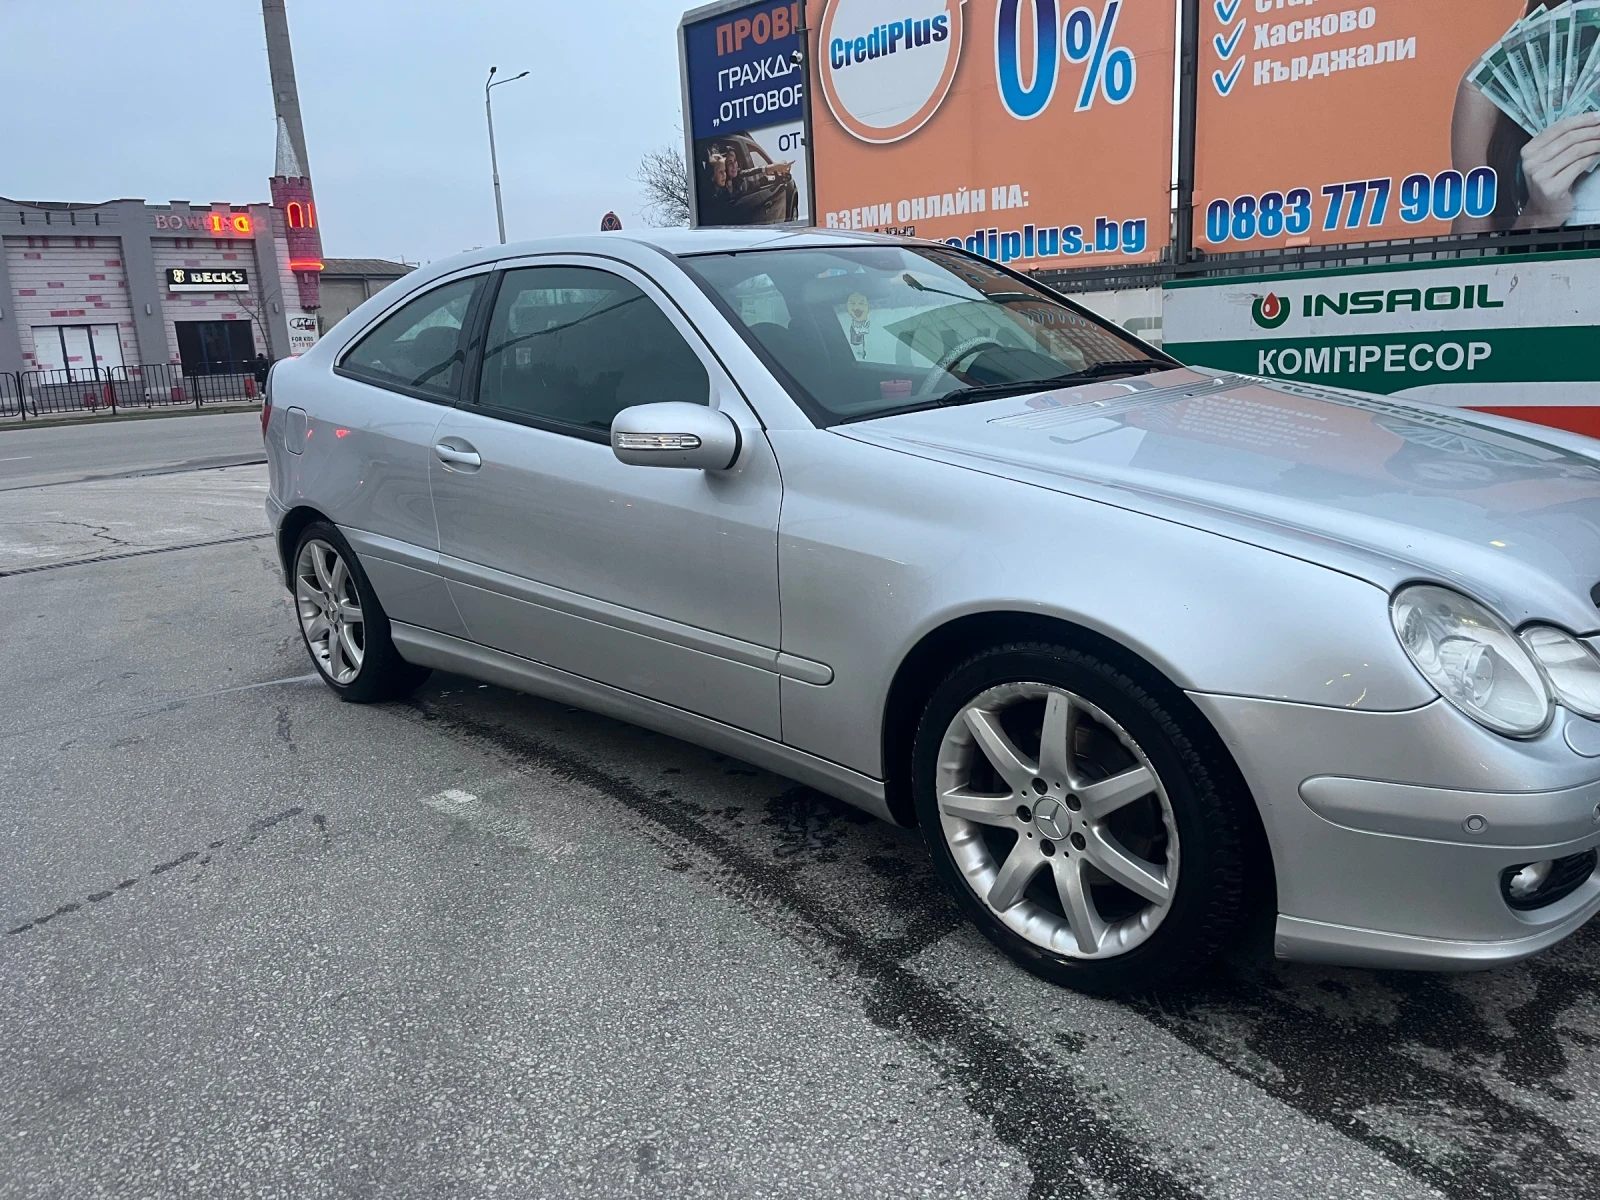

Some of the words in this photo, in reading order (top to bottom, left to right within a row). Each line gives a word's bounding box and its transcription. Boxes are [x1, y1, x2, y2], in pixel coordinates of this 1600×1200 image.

[830, 14, 949, 70] CrediPlus
[1253, 6, 1376, 50] Хасково
[995, 0, 1136, 120] 0%
[1253, 36, 1416, 86] Кърджали
[825, 201, 893, 230] ВЗЕМИ
[897, 187, 985, 223] ОНЛАЙН
[991, 184, 1030, 211] НА:
[1206, 188, 1312, 244] 0883
[1321, 176, 1392, 232] 777
[1399, 165, 1498, 224] 900
[190, 270, 244, 283] BECK'S
[1302, 283, 1505, 318] INSAOIL
[1257, 341, 1493, 376] КОМПРЕСОР
